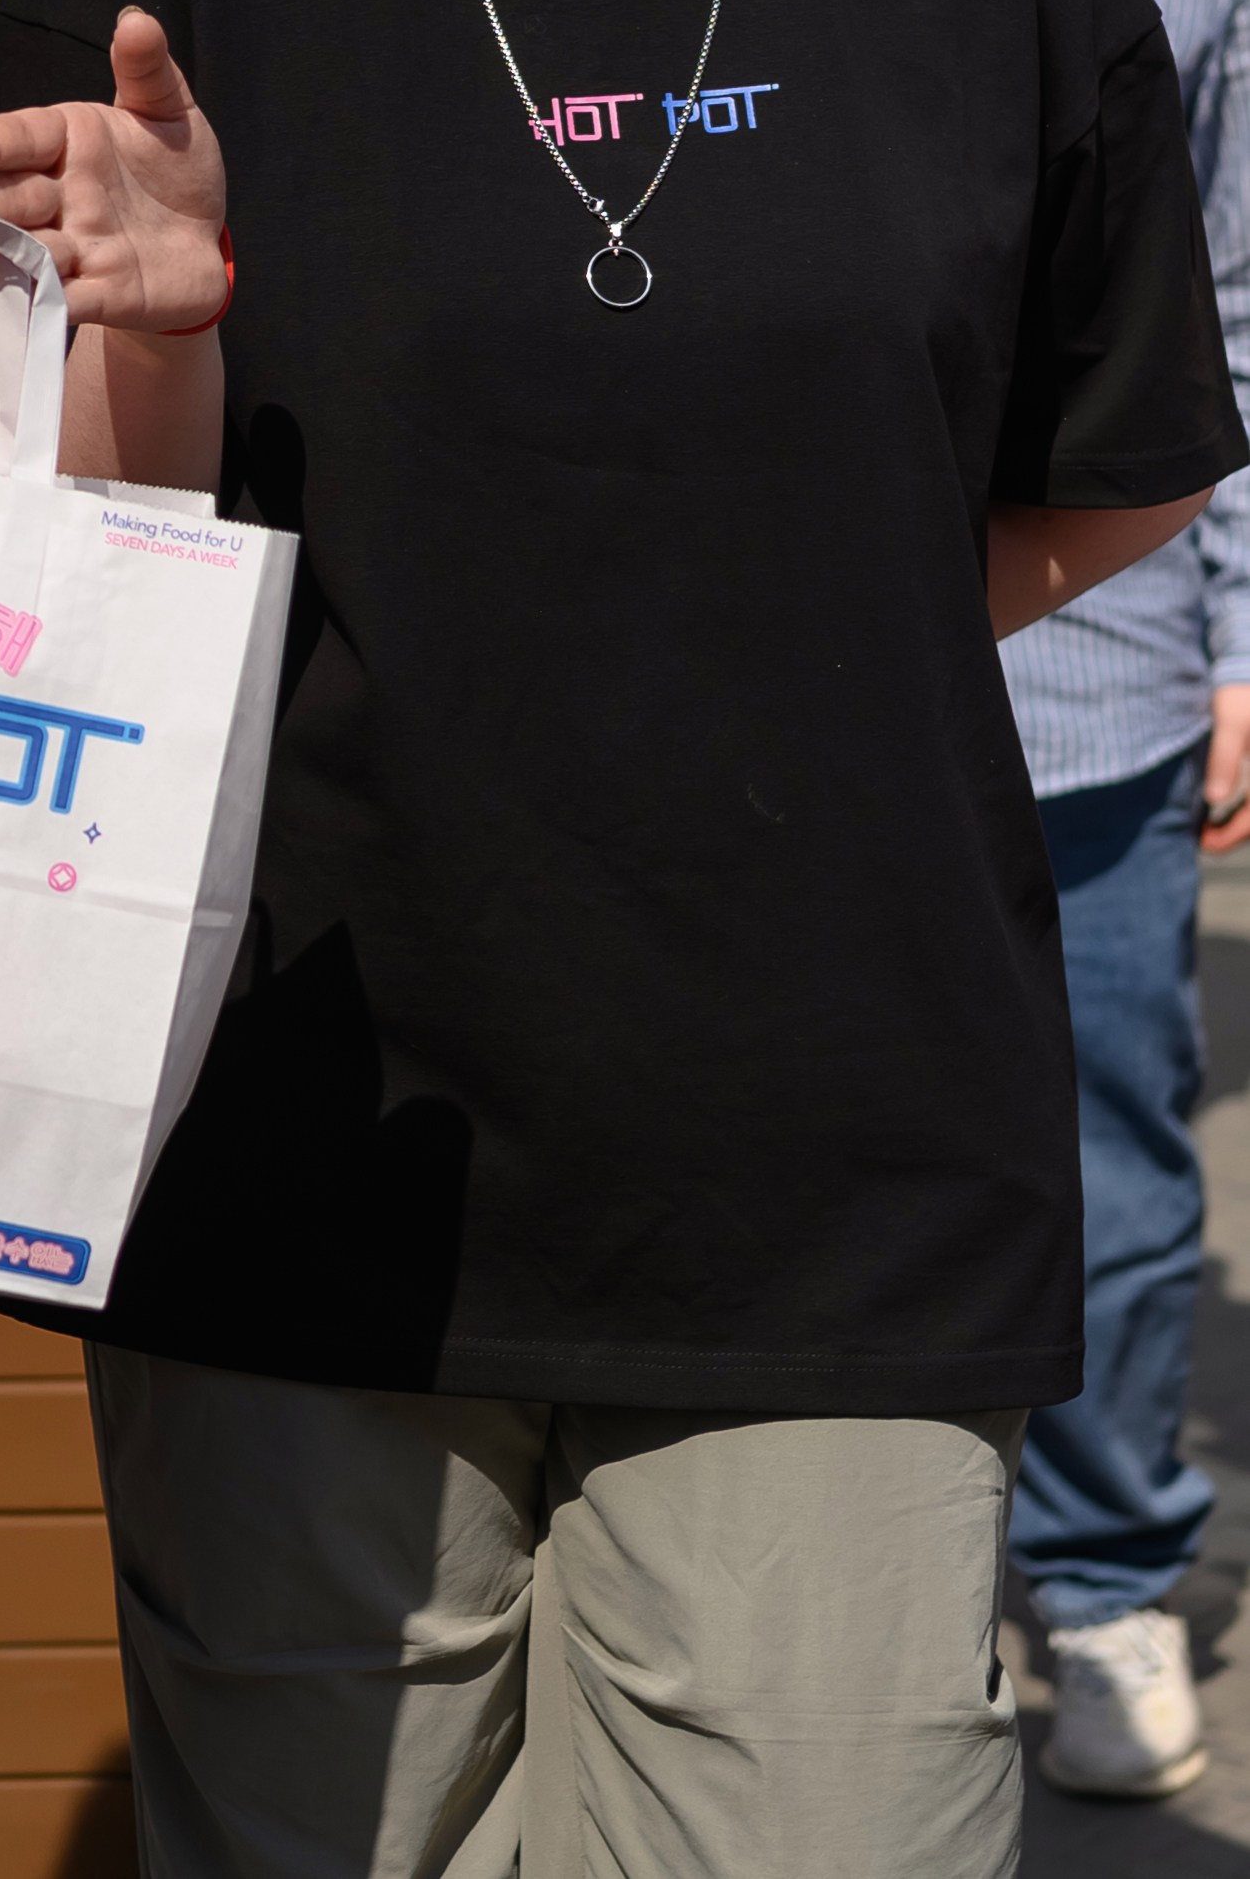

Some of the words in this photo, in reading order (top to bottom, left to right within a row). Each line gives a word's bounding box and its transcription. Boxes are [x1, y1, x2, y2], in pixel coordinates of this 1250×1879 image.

[528, 92, 644, 147] HOT
[661, 82, 780, 136] POT
[101, 510, 158, 539] Making
[161, 522, 203, 544] Food
[205, 530, 227, 549] for
[230, 536, 244, 552] U
[104, 531, 149, 552] SEVEN
[150, 540, 186, 559] DAYS
[186, 548, 198, 562] A
[200, 550, 239, 570] WEEK
